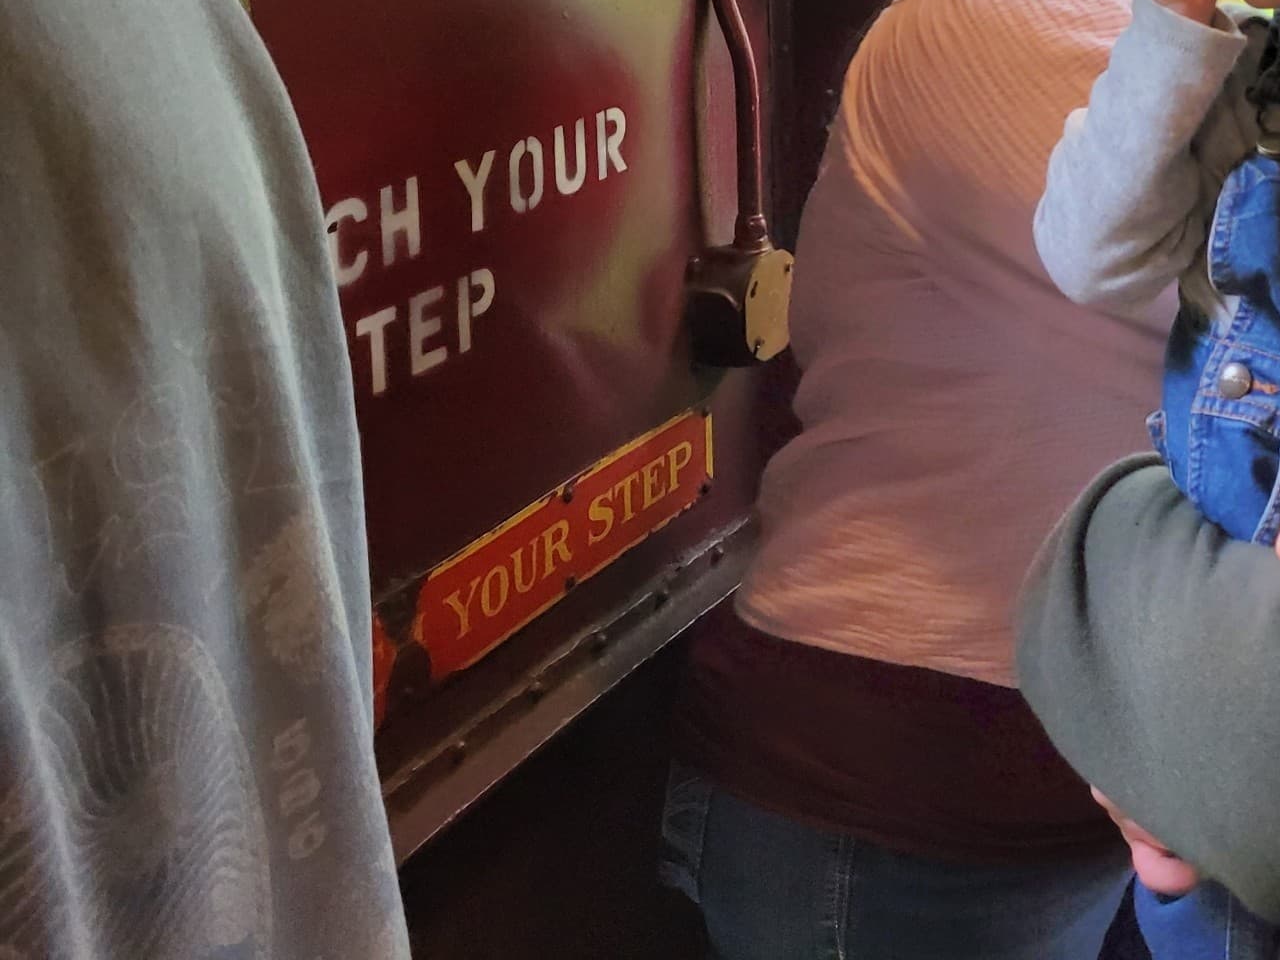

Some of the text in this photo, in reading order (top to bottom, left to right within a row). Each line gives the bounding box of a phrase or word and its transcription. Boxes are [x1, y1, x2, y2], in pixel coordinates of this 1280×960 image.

[455, 107, 628, 232] YOUR
[442, 441, 693, 639] YOUR STEP
